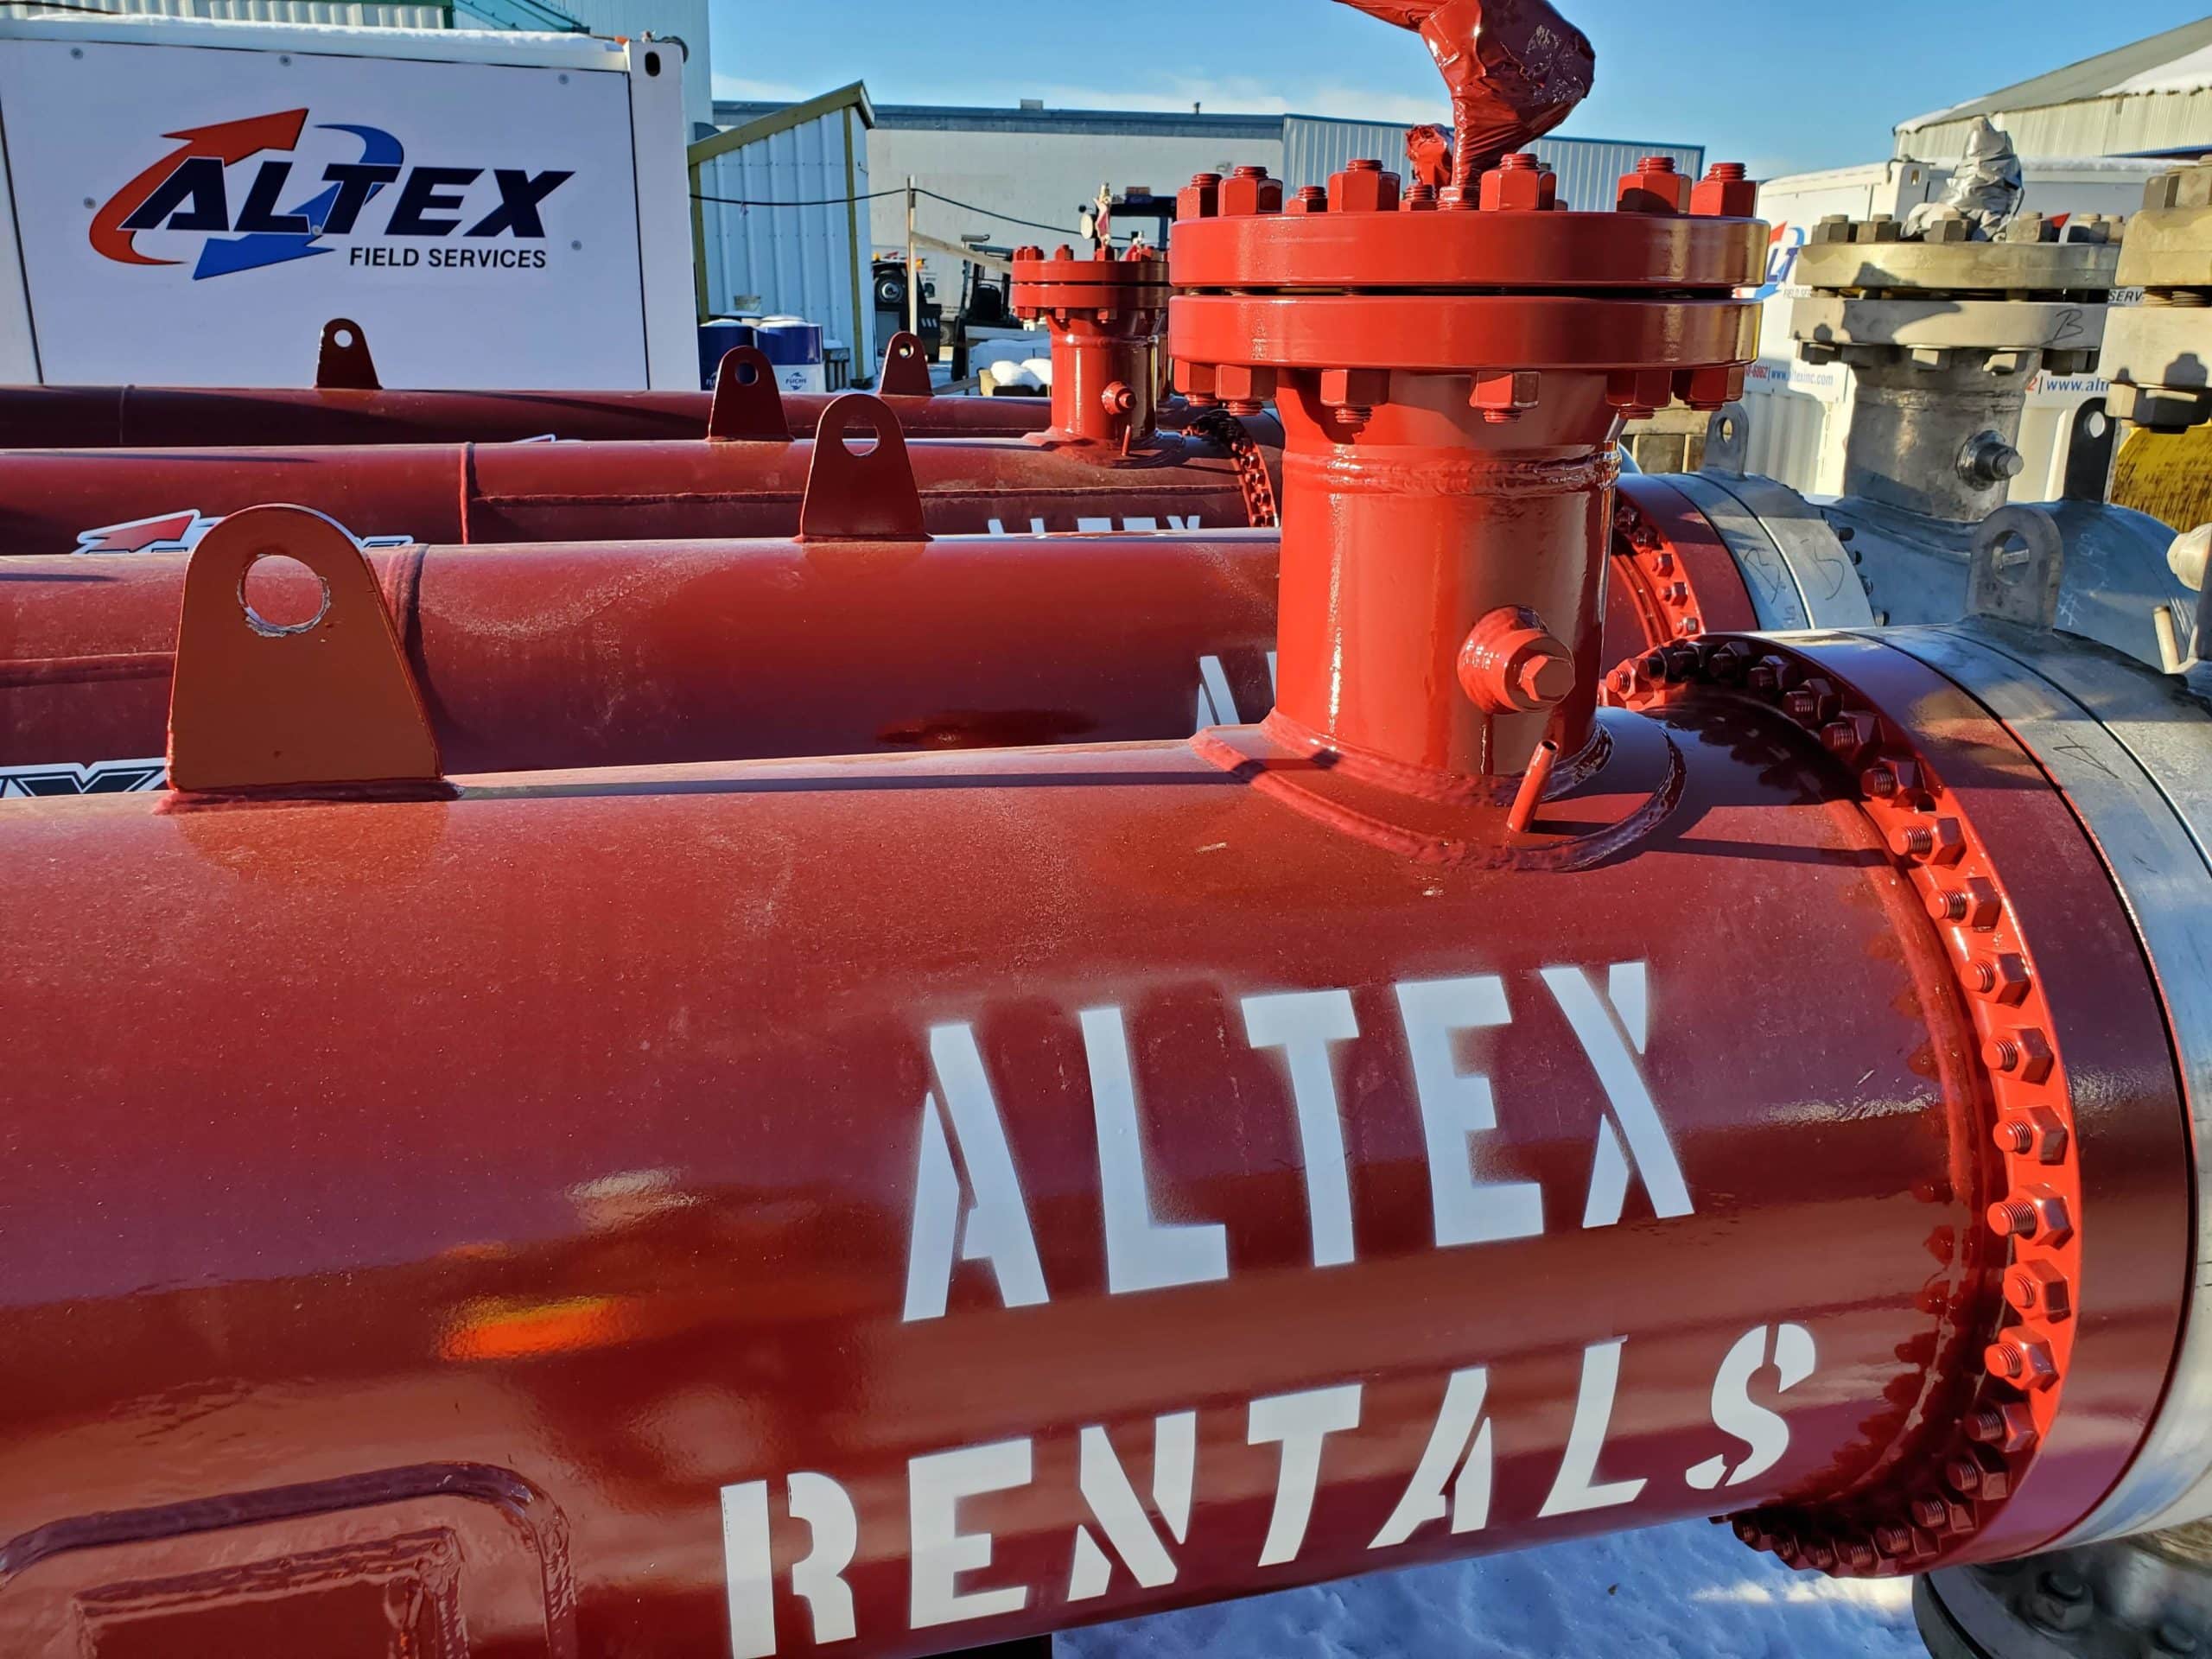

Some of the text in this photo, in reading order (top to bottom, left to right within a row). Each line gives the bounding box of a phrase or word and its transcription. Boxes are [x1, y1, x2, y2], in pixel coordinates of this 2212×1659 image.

[118, 157, 576, 238] ALTEX
[349, 247, 546, 268] FIELD SERVICES
[2040, 308, 2084, 346] B
[903, 962, 1694, 1322] ALTEX
[720, 1323, 1815, 1659] RENTALS
